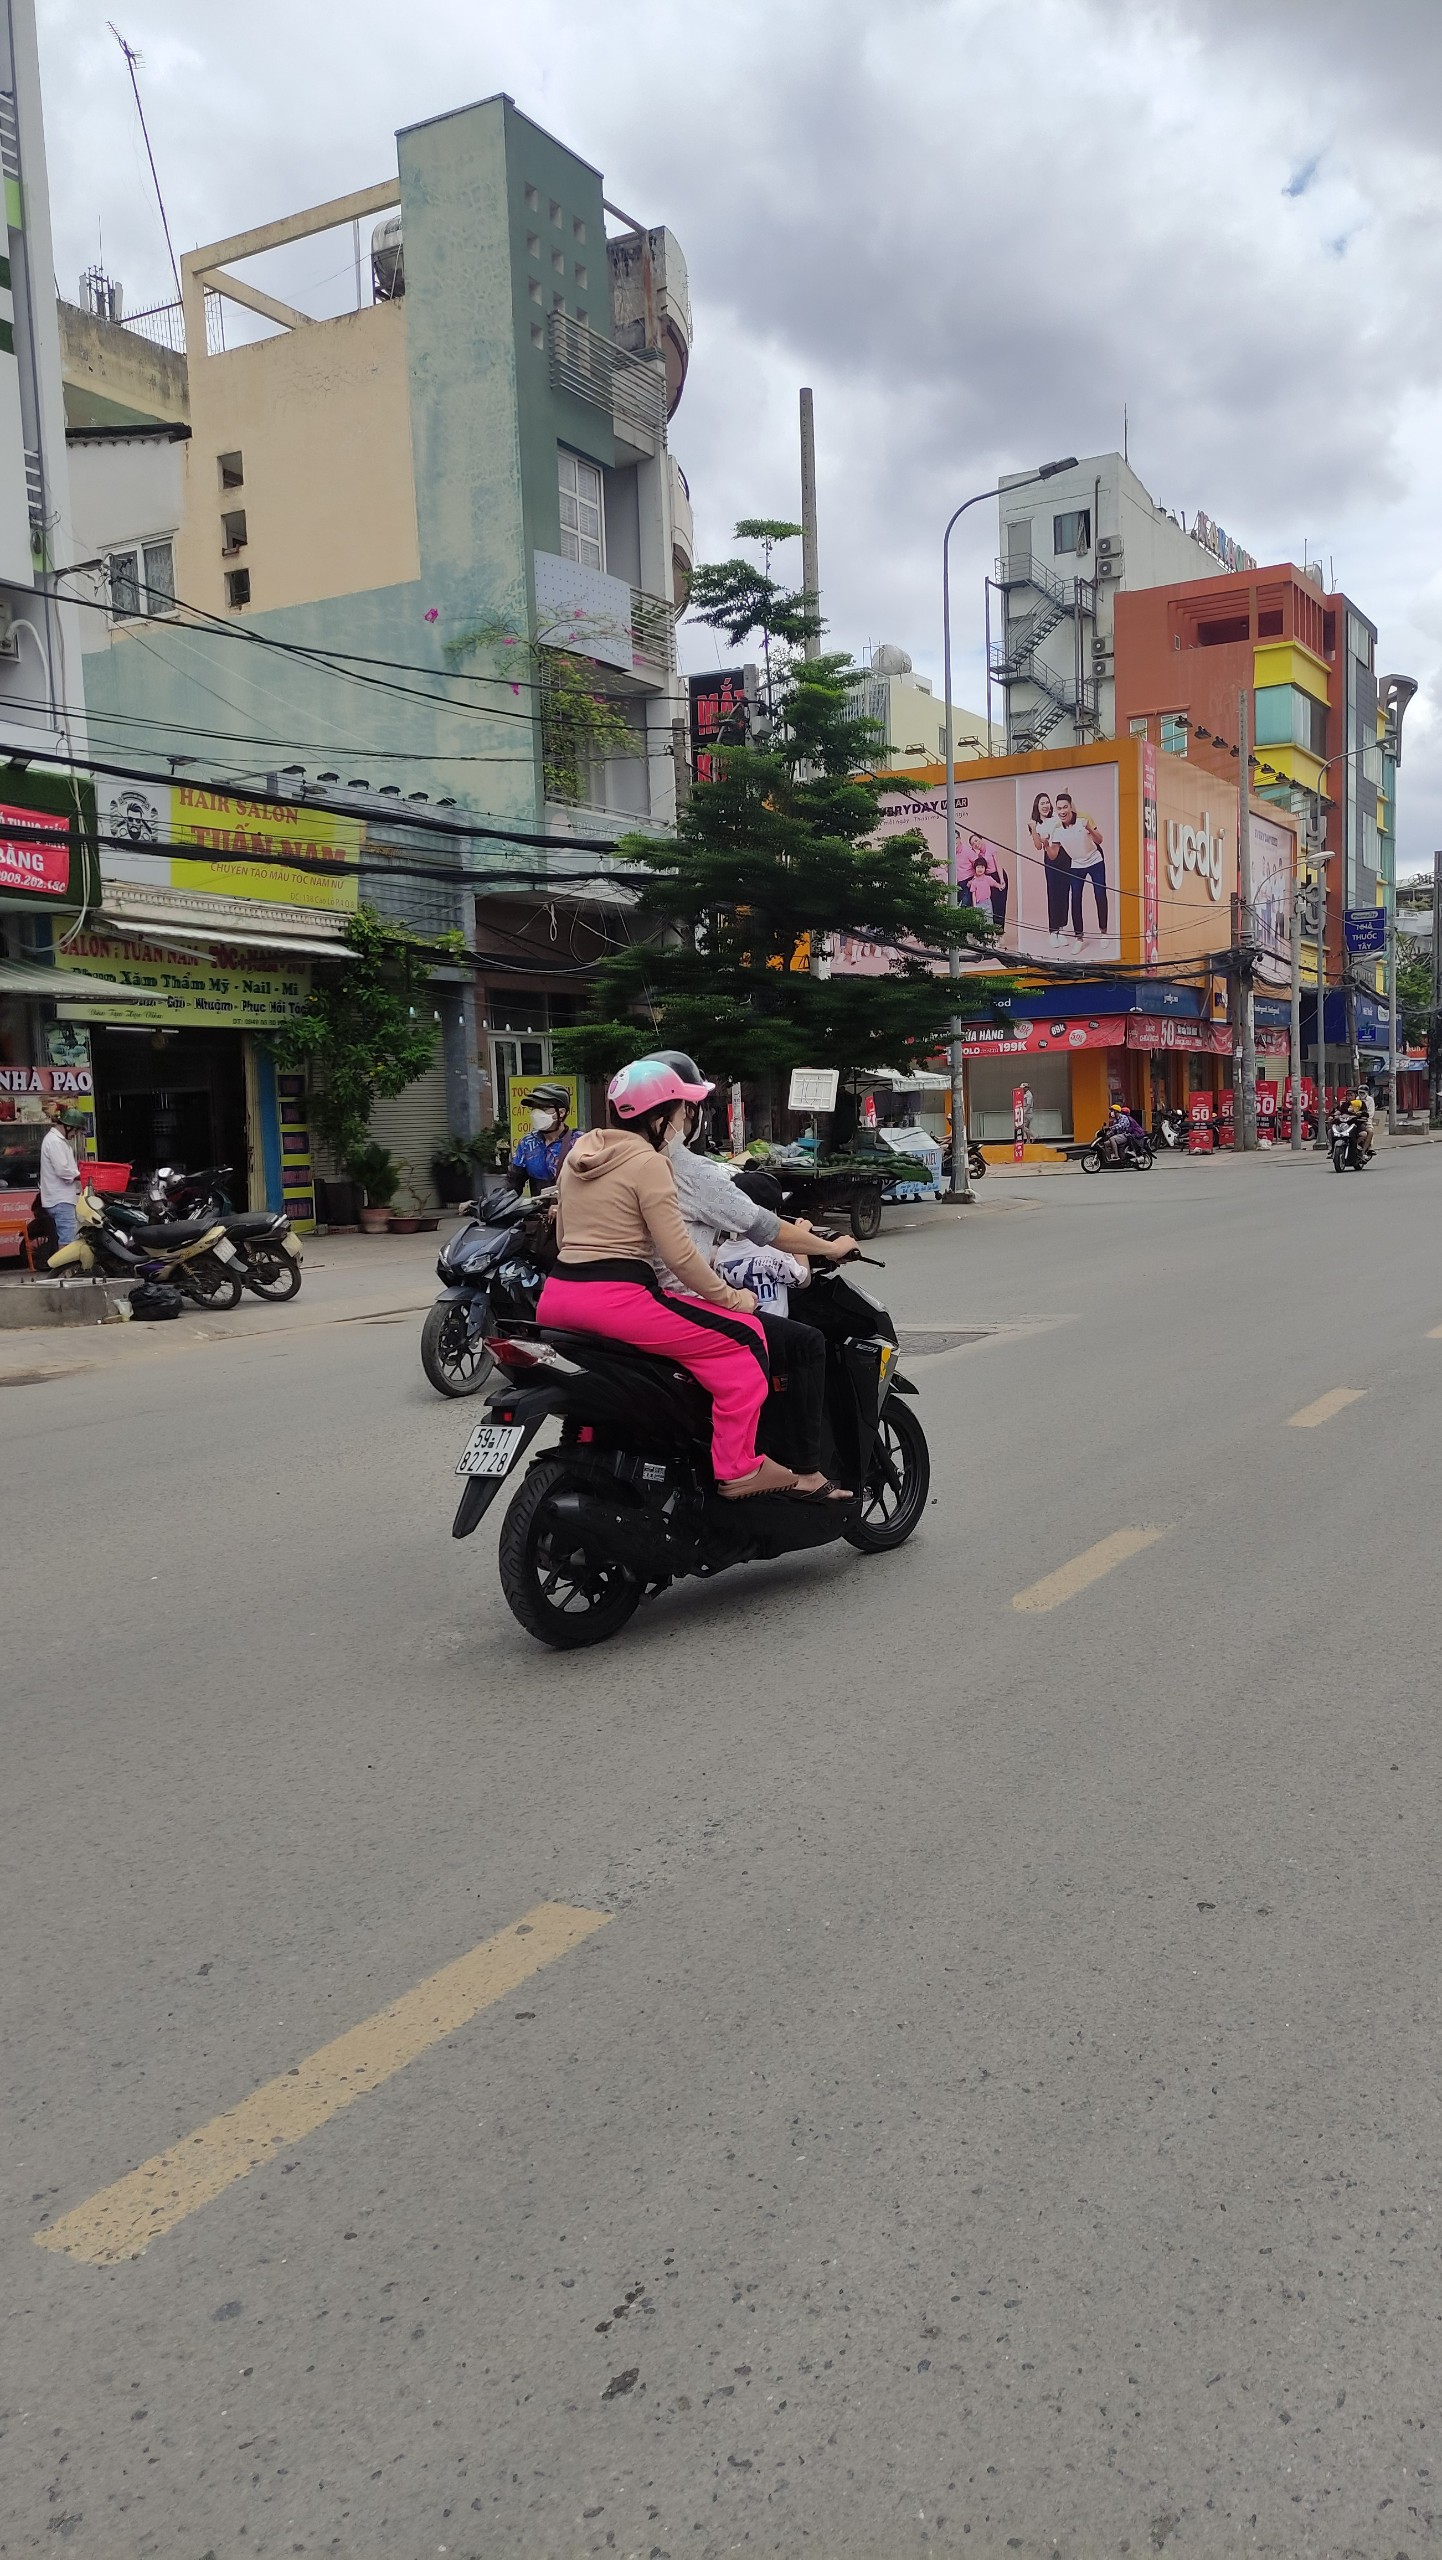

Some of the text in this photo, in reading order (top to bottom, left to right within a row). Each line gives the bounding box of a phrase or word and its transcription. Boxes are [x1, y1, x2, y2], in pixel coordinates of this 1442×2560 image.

[179, 787, 298, 825] HAIR SALON
[1165, 811, 1225, 901] yody
[310, 876, 330, 888] NAM
[208, 978, 230, 994] Mỹ
[242, 980, 271, 995] Nail
[1050, 1023, 1066, 1036] 89K
[1161, 1020, 1174, 1046] 50
[998, 1041, 1028, 1053] 199K
[52, 1071, 92, 1091] PAO
[1192, 1108, 1209, 1121] 50
[459, 1451, 509, 1472] 827.28
